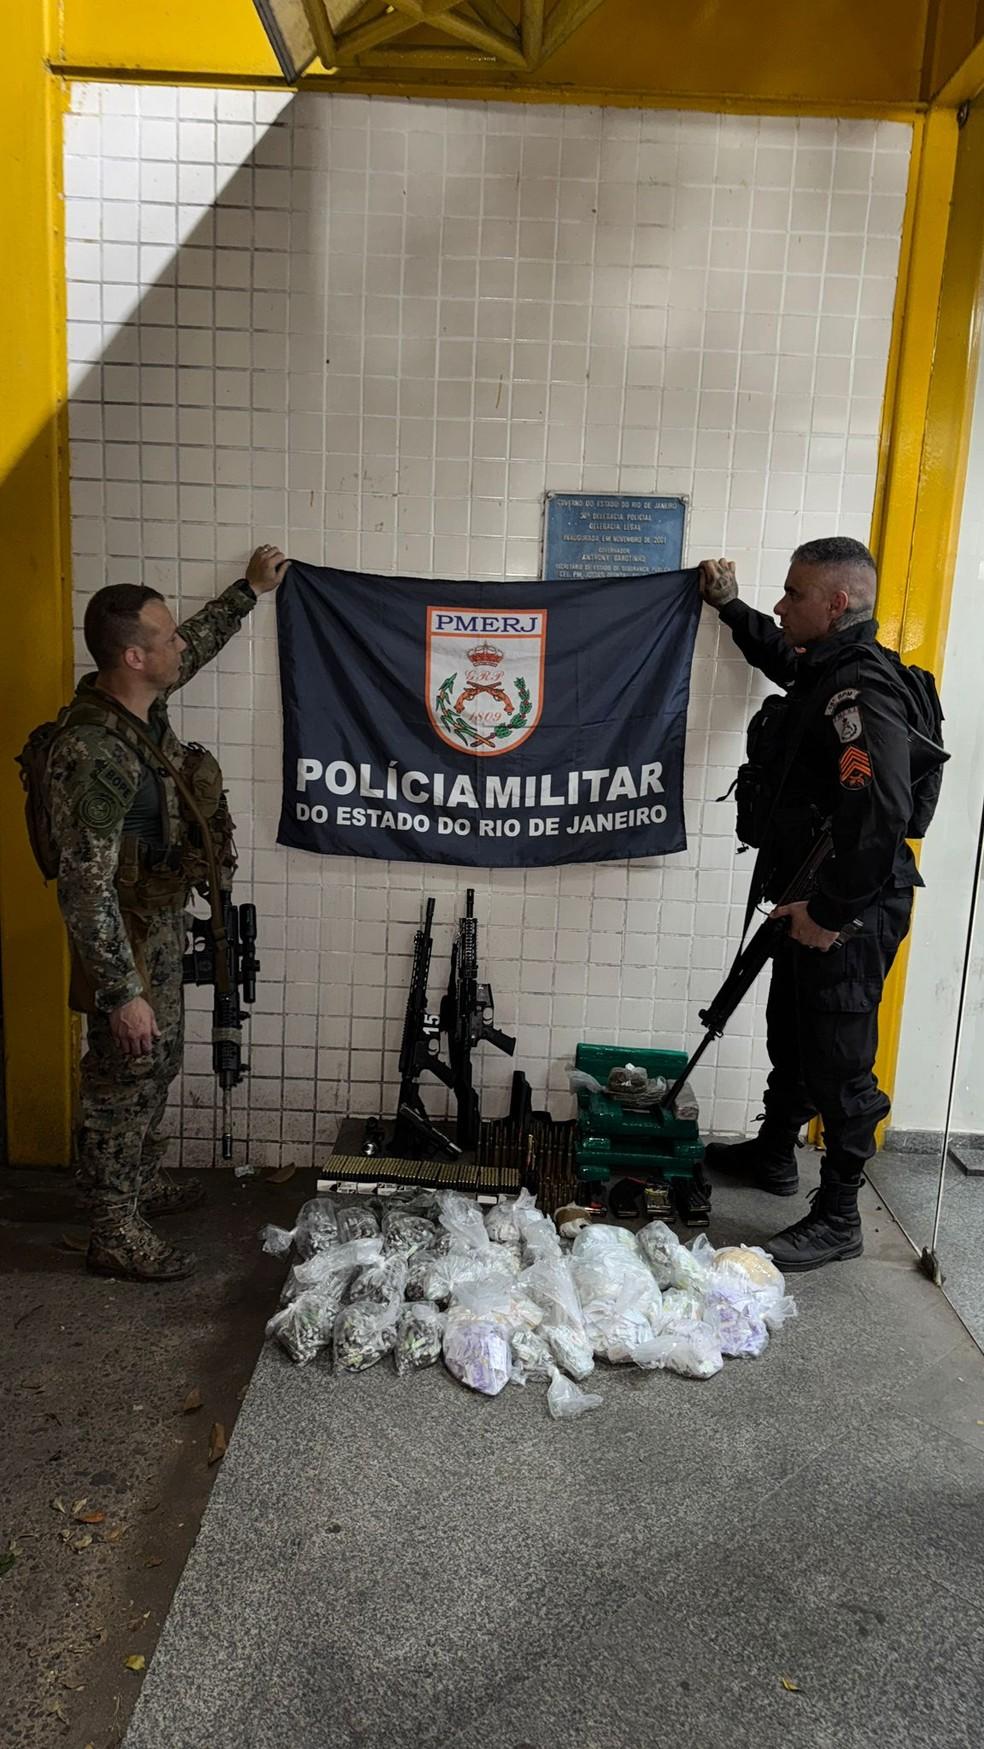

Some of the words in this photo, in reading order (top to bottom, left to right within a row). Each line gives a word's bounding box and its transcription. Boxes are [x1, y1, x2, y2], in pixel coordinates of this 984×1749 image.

[596, 500, 620, 509] ESTADO
[631, 501, 641, 509] RIO
[644, 501, 652, 509] DE
[654, 502, 678, 510] JANEIRO
[588, 523, 621, 531] DELEGACIA
[626, 513, 652, 521] POLICIAL
[435, 613, 539, 633] PMERJ
[468, 711, 503, 723] 1809
[105, 769, 131, 799] BOPE
[295, 757, 479, 809] POLÍCIA
[485, 761, 665, 809] MILITAR
[296, 802, 329, 825] DO
[336, 807, 430, 833] ESTADO
[437, 817, 471, 836] DO
[479, 818, 521, 837] RIO
[528, 817, 559, 837] DE
[566, 804, 668, 835] JANEIRO
[423, 1014, 441, 1035] 15
